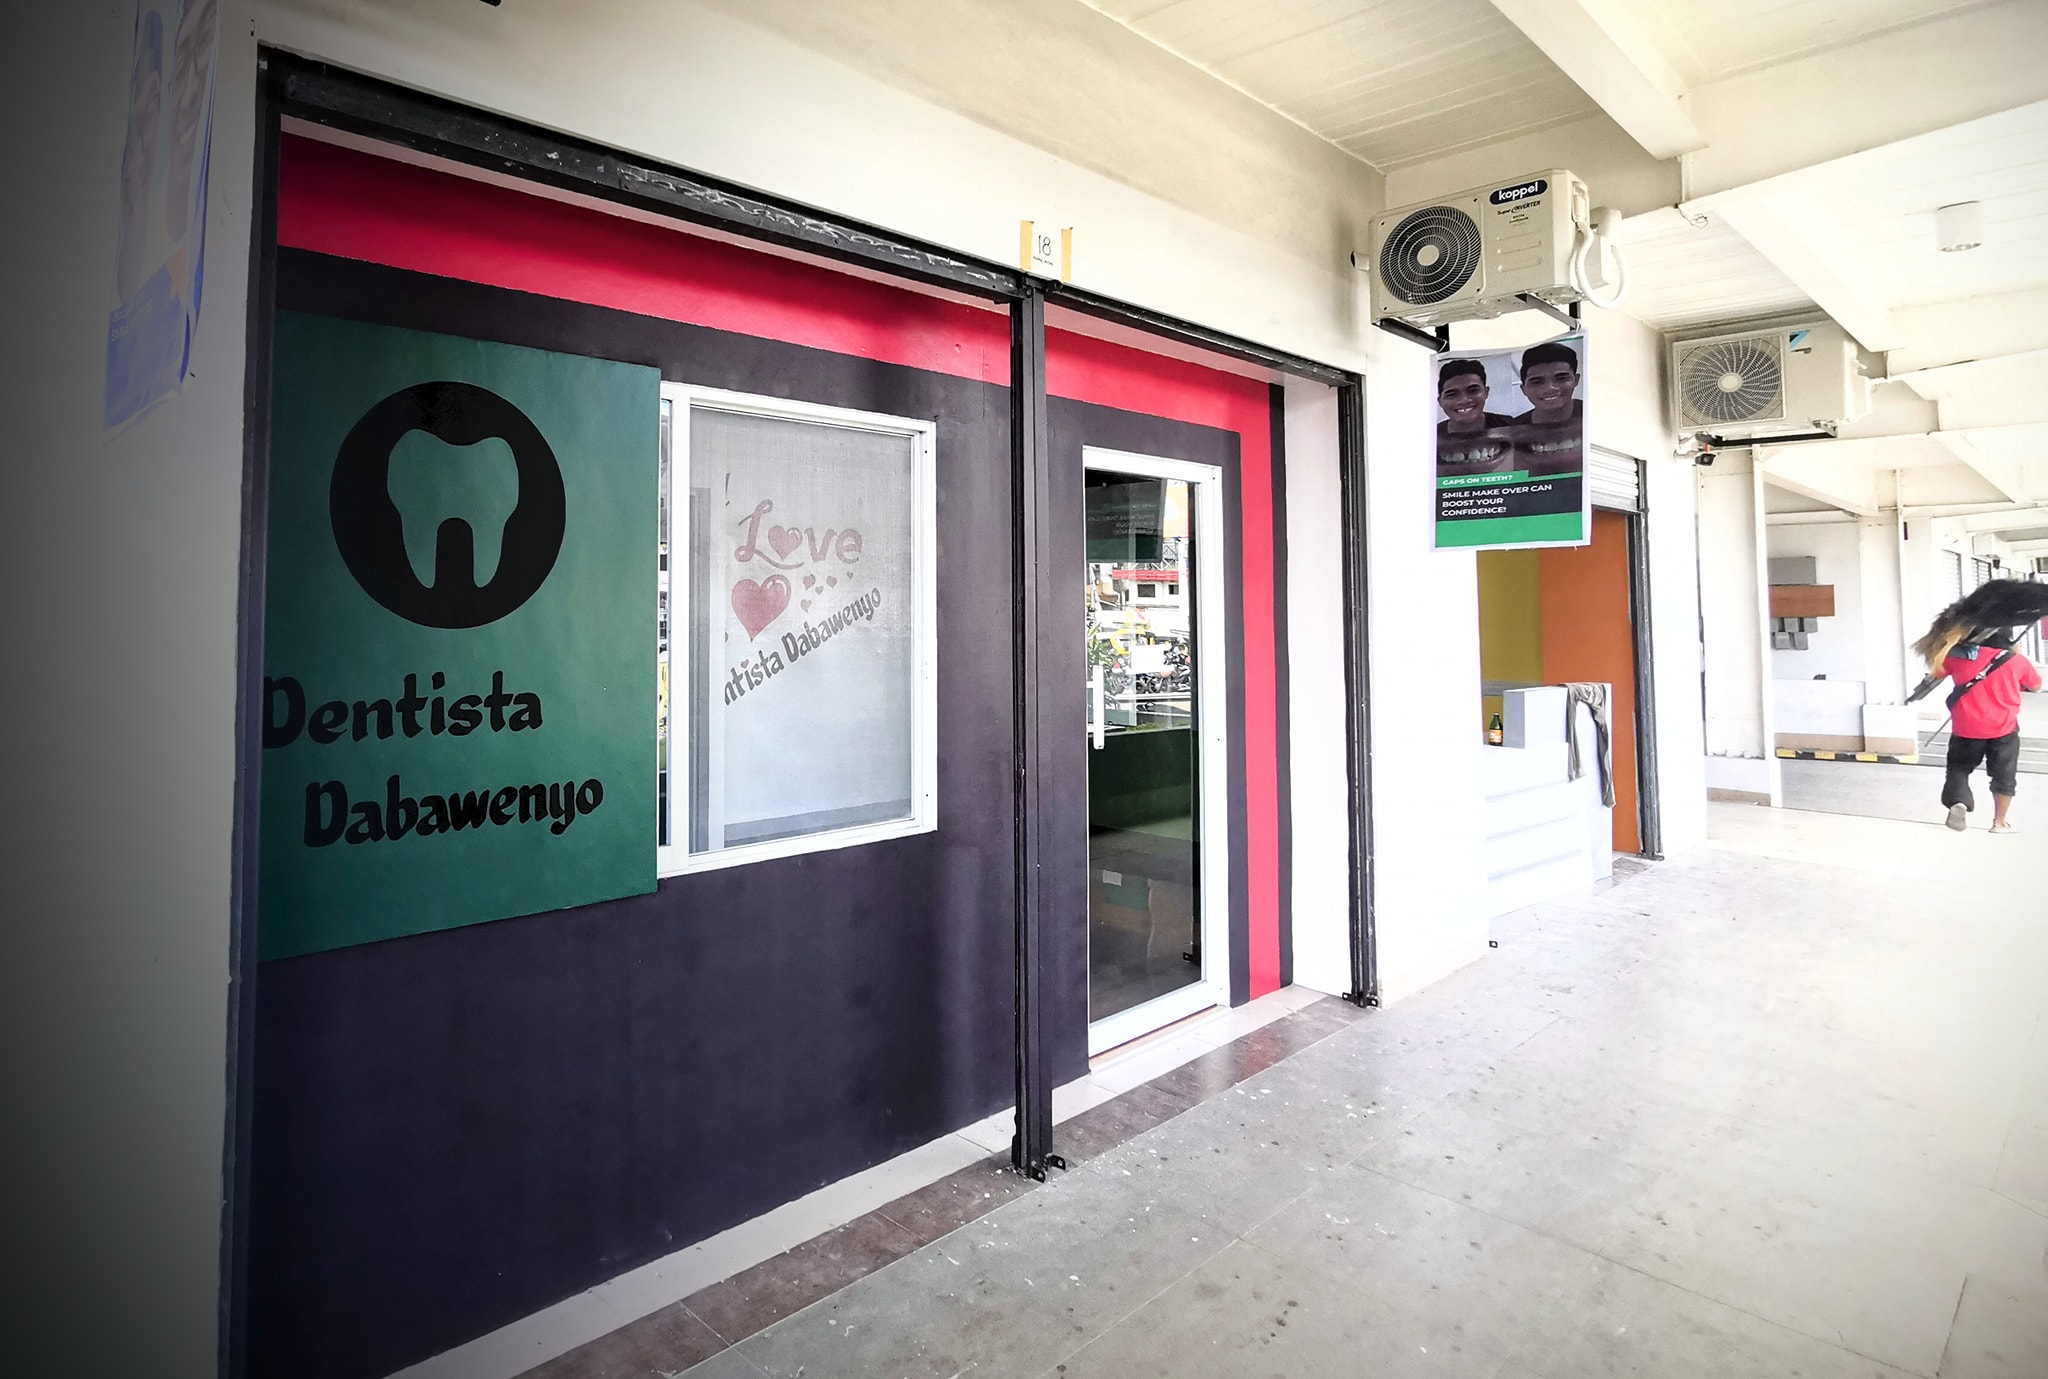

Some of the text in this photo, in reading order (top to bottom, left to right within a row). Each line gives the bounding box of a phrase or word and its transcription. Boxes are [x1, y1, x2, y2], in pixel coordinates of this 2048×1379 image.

[1498, 181, 1538, 201] koppel
[1038, 234, 1052, 257] 18
[1480, 474, 1513, 483] TEETH?
[1442, 483, 1553, 499] SMILE MAKE OVER CAN
[1441, 506, 1507, 517] CONFIDENCE!
[1442, 497, 1504, 508] BOOST YOUR
[780, 587, 882, 663] Dabawenyo
[262, 670, 543, 749] Dentista
[304, 774, 604, 848] Dabawenyo
